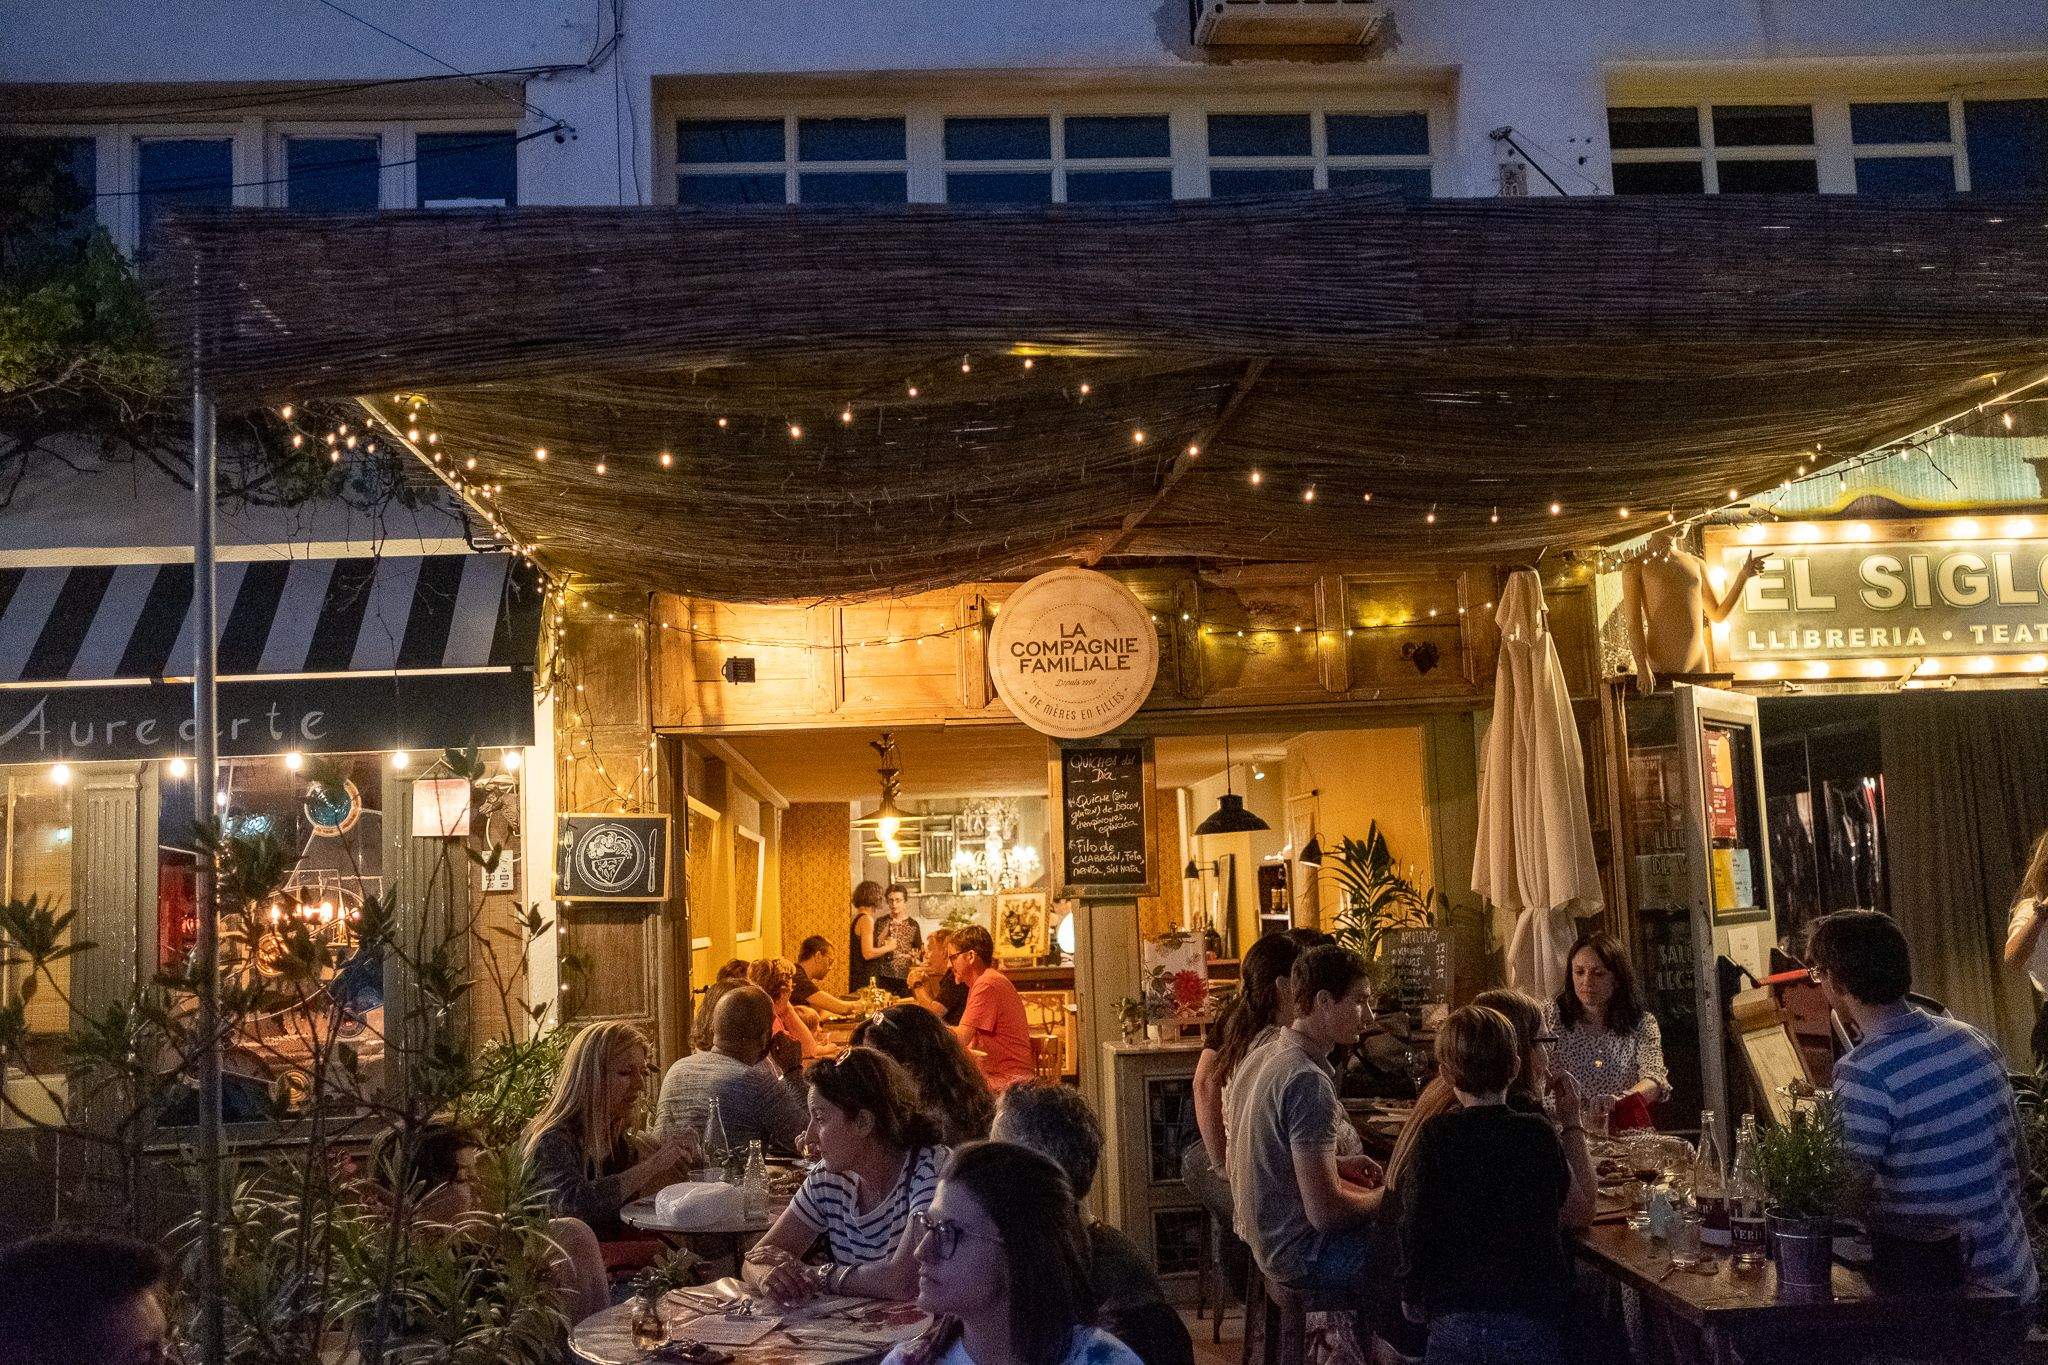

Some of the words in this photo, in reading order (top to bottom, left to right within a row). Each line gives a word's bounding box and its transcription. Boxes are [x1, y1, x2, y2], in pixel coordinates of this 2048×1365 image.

[1744, 557, 1837, 613] EL
[1859, 552, 2048, 611] SIGL
[1060, 622, 1087, 639] LA
[1747, 626, 1927, 651] LLIBRERIA
[1010, 637, 1139, 658] COMPAGNIE
[1019, 655, 1131, 674] FAMILIALE
[1029, 695, 1043, 710] DE
[1081, 709, 1094, 720] EN
[1096, 691, 1126, 716] FILLES
[1099, 841, 1115, 852] de
